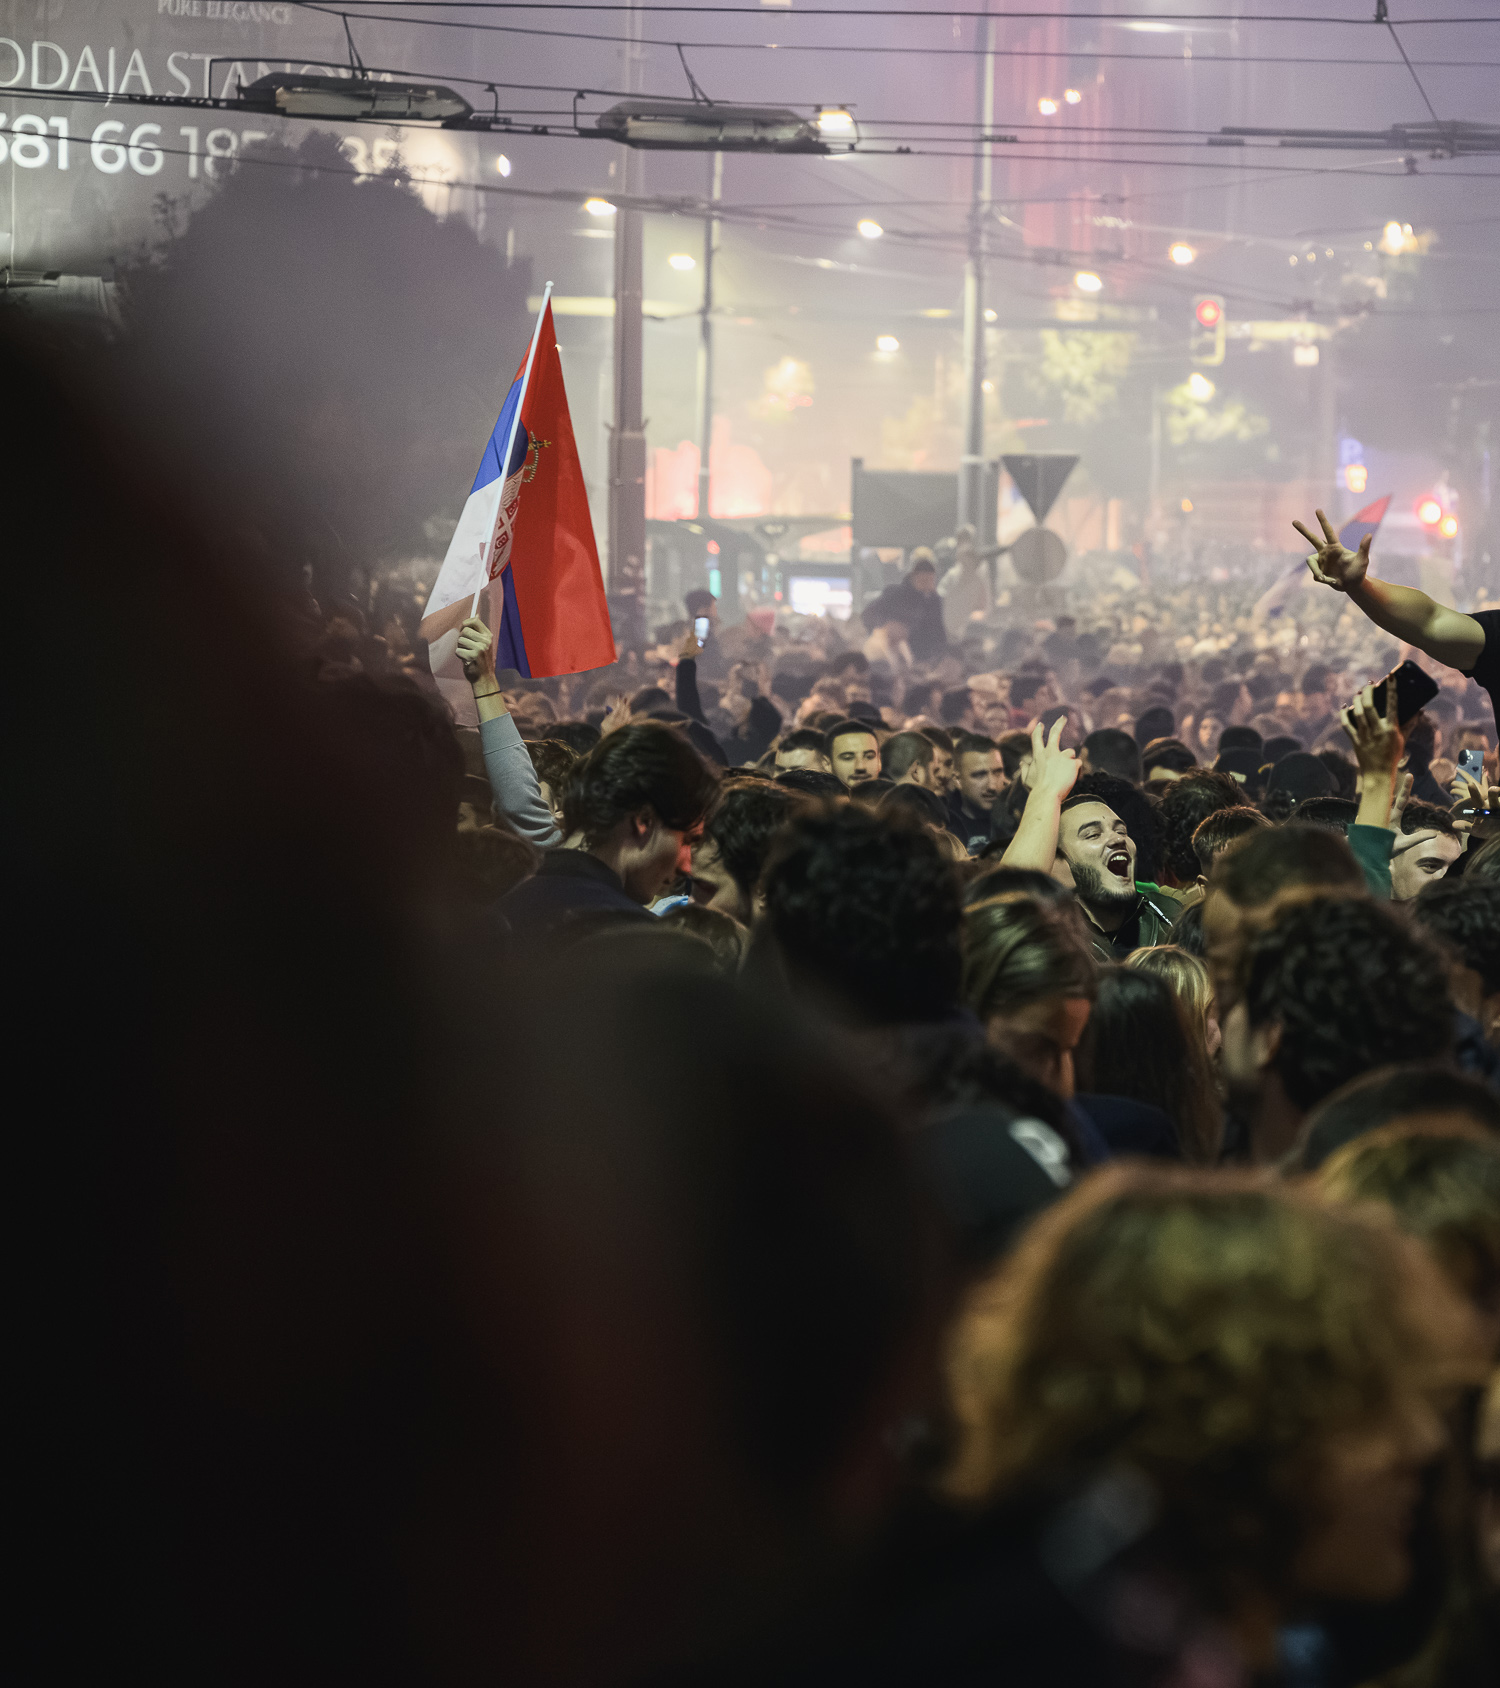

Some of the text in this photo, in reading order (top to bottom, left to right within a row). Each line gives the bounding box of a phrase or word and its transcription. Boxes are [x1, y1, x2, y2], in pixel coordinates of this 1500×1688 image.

[158, 0, 293, 24] PURE ELEGANCE
[0, 112, 69, 170] 81
[91, 120, 163, 176] 66
